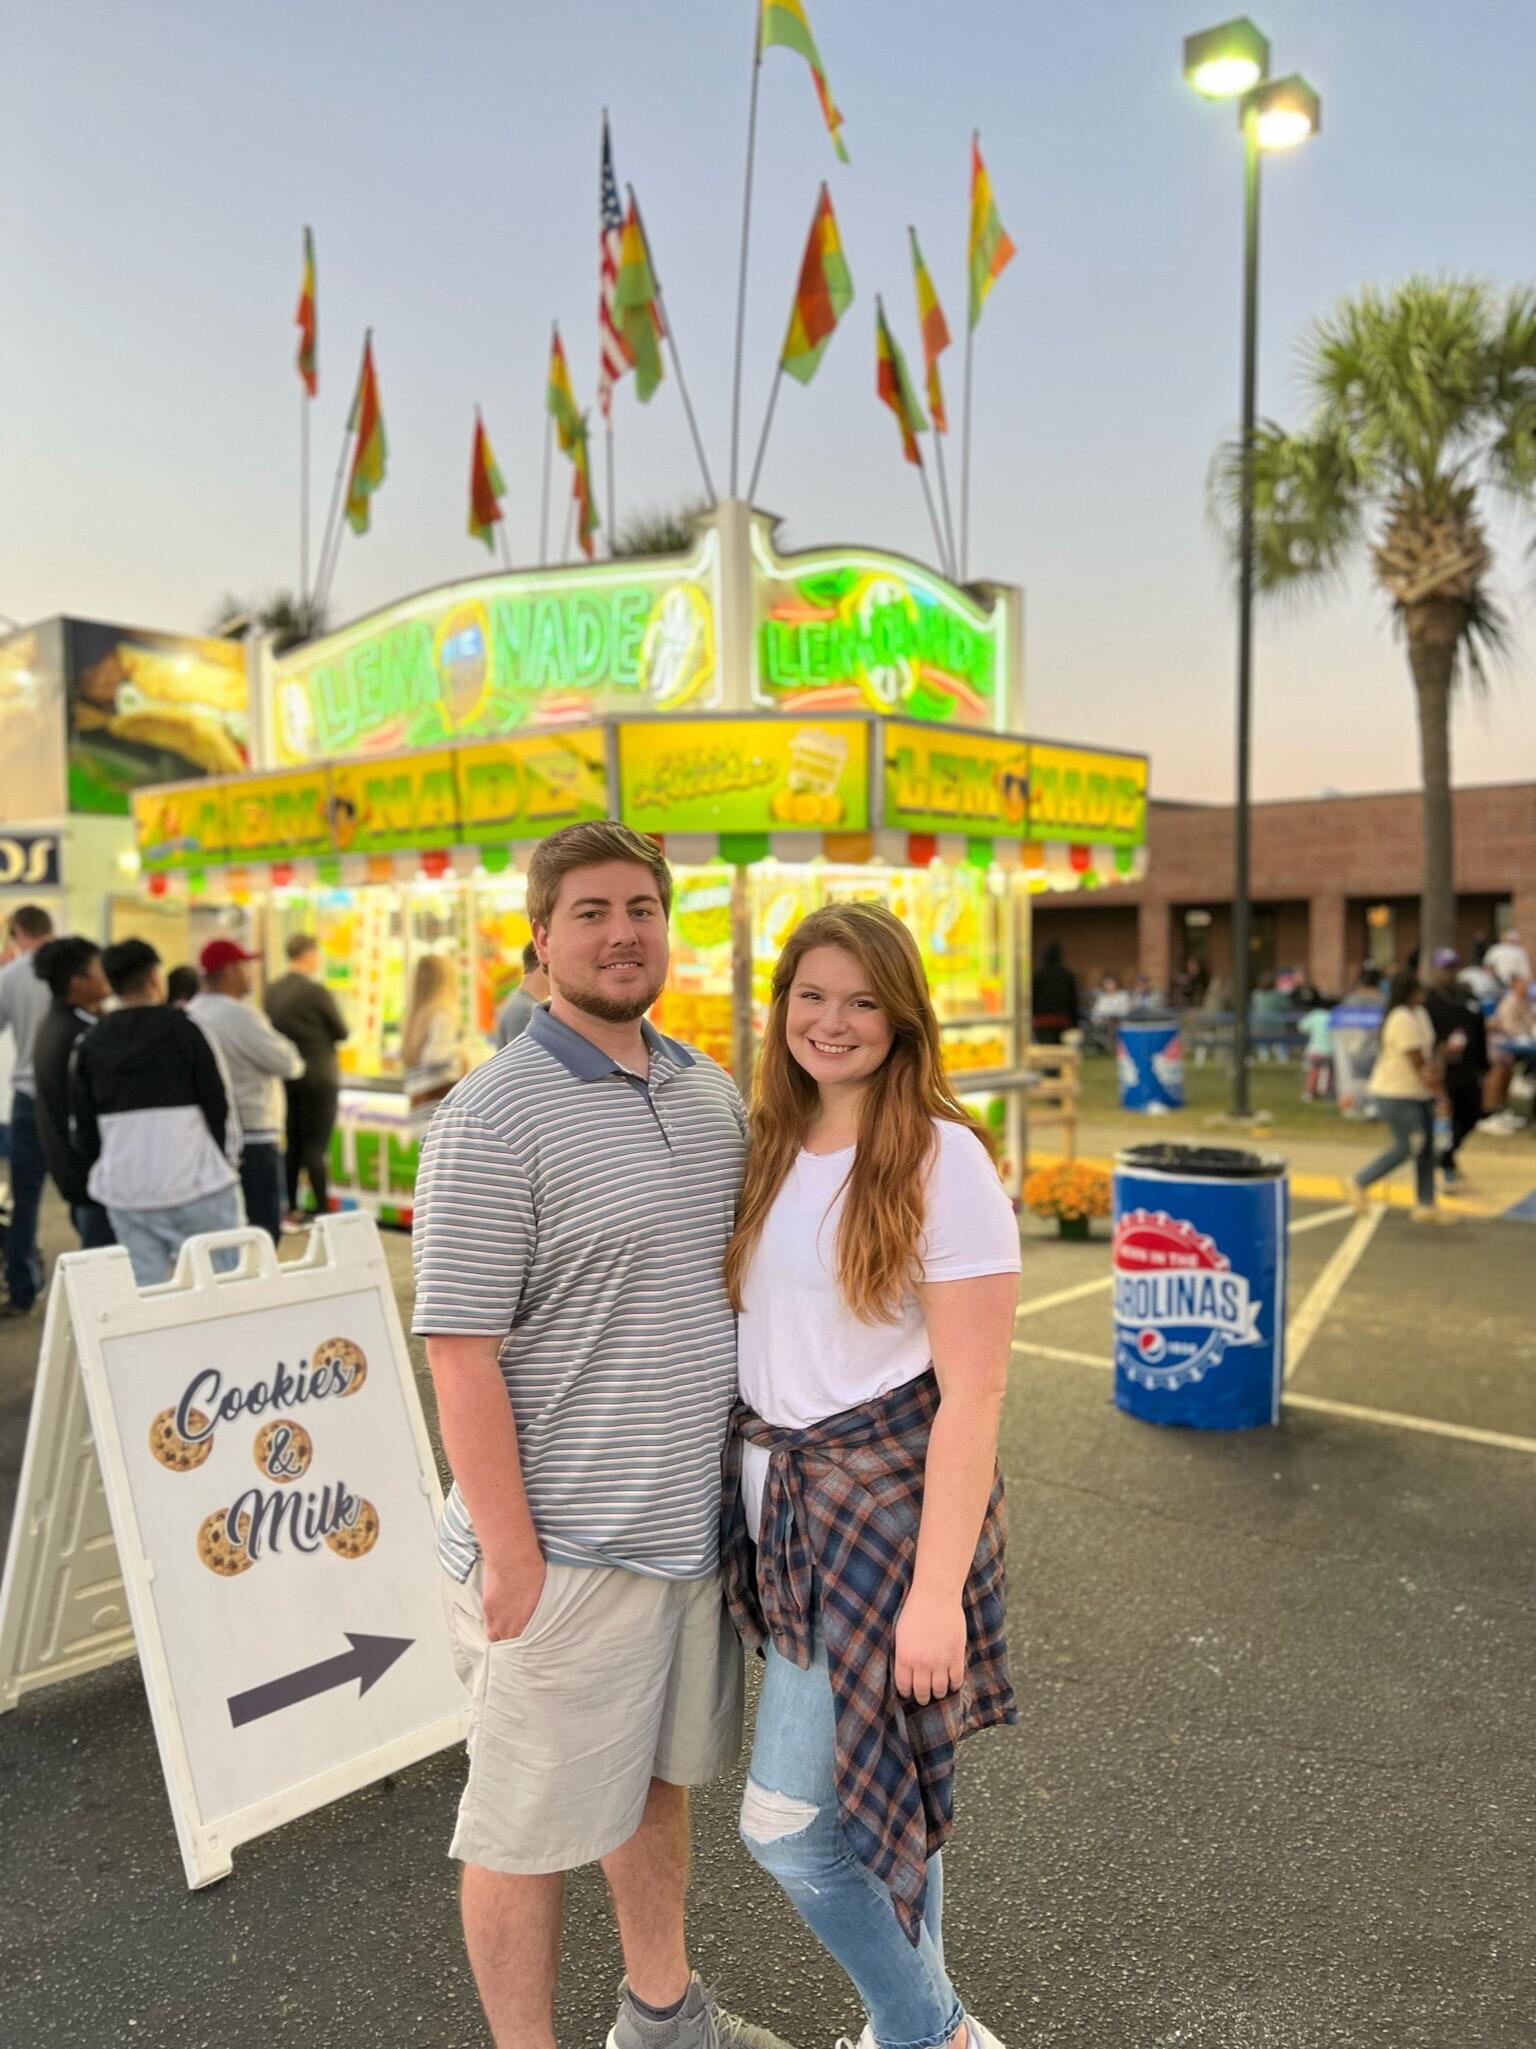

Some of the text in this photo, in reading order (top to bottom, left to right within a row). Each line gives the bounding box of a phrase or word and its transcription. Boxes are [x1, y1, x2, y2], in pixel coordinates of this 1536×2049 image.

[177, 1360, 351, 1440] Cookies
[268, 1428, 303, 1475] &
[227, 1481, 357, 1560] Milk
